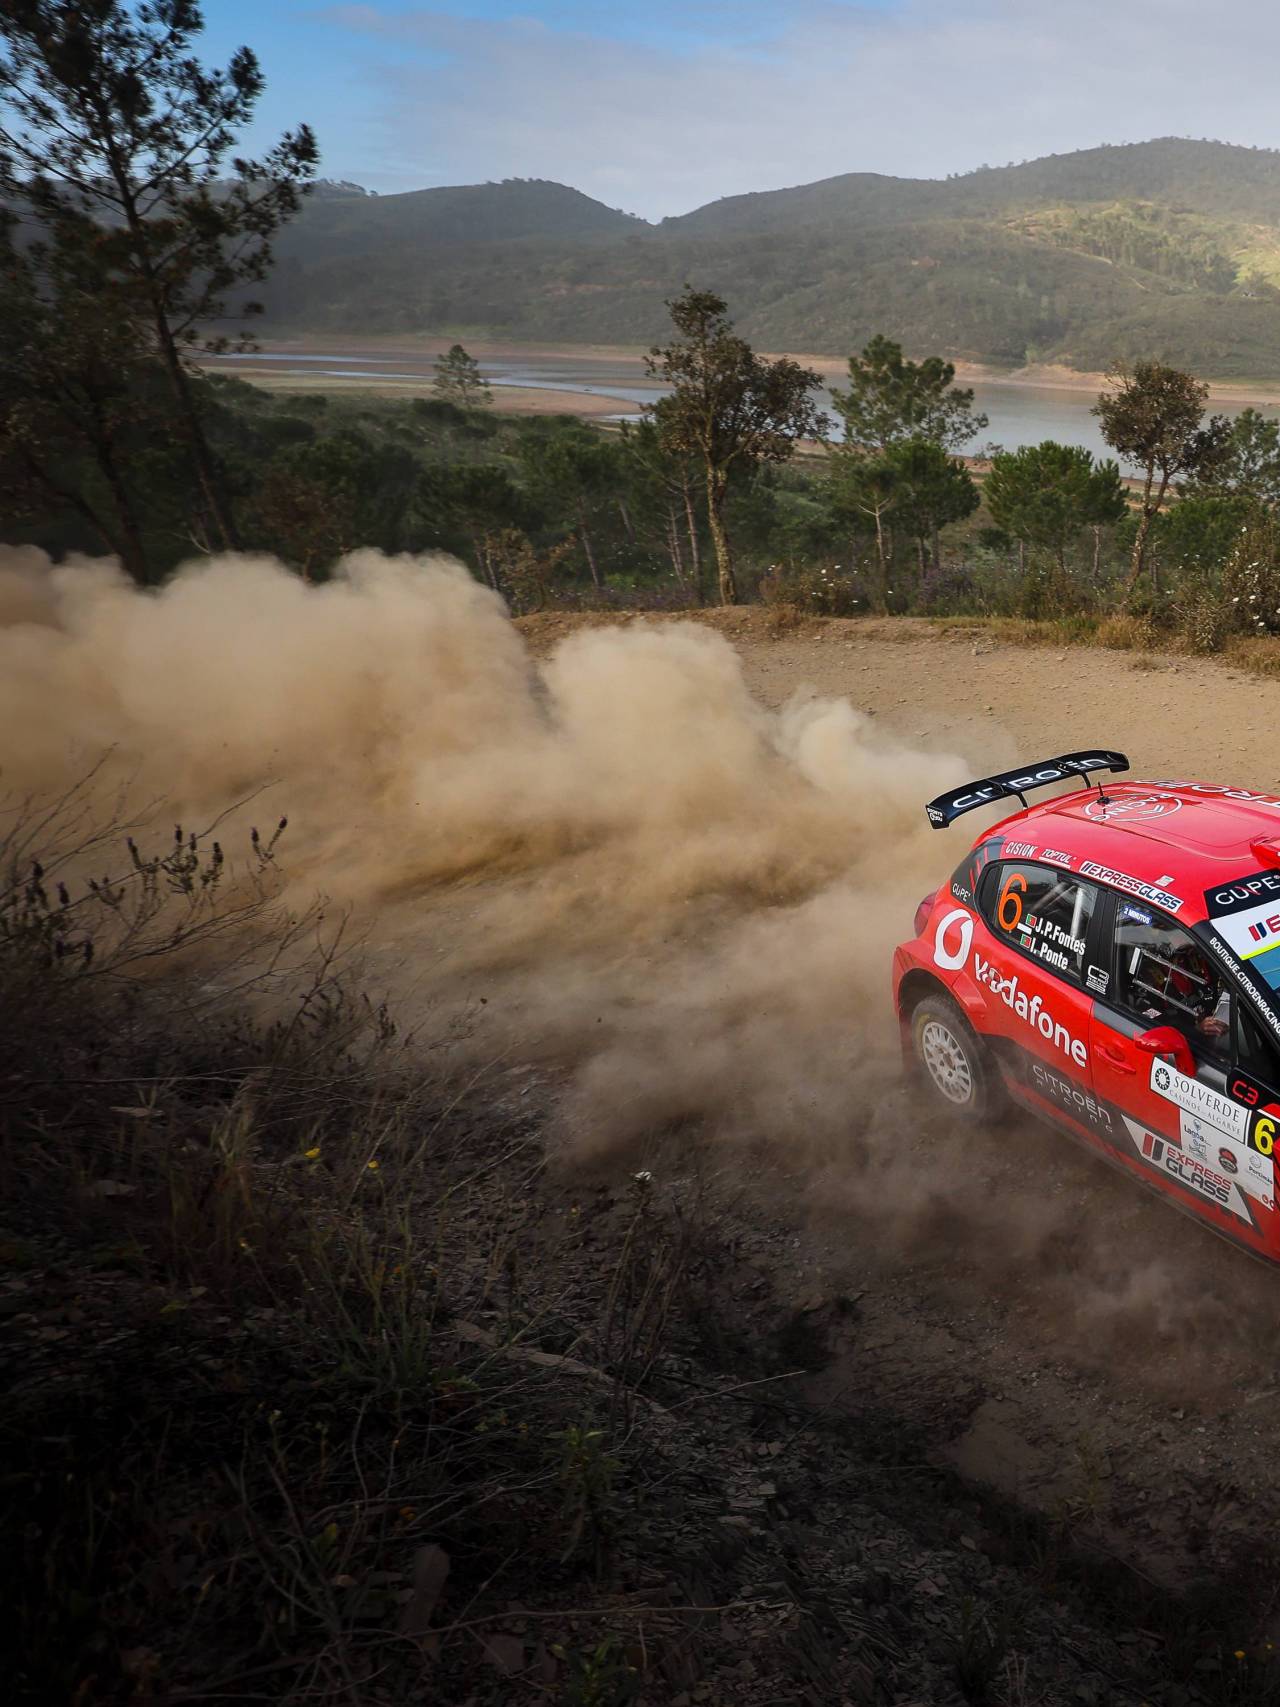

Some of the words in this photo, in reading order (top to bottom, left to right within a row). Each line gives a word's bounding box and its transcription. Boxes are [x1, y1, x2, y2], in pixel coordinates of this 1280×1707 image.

[1005, 841, 1038, 858] CISION
[1041, 849, 1071, 864] TOPTUL
[998, 873, 1028, 931] 6
[1040, 943, 1069, 970] Ponte
[975, 952, 1088, 1068] vodafone
[1173, 1076, 1240, 1123] SOLVERDE
[1232, 1080, 1259, 1105] C3
[1207, 1112, 1241, 1135] ALGARVE
[1254, 1118, 1276, 1155] 6
[1166, 1145, 1233, 1192] EXPRESS
[1166, 1158, 1230, 1204] GLASS
